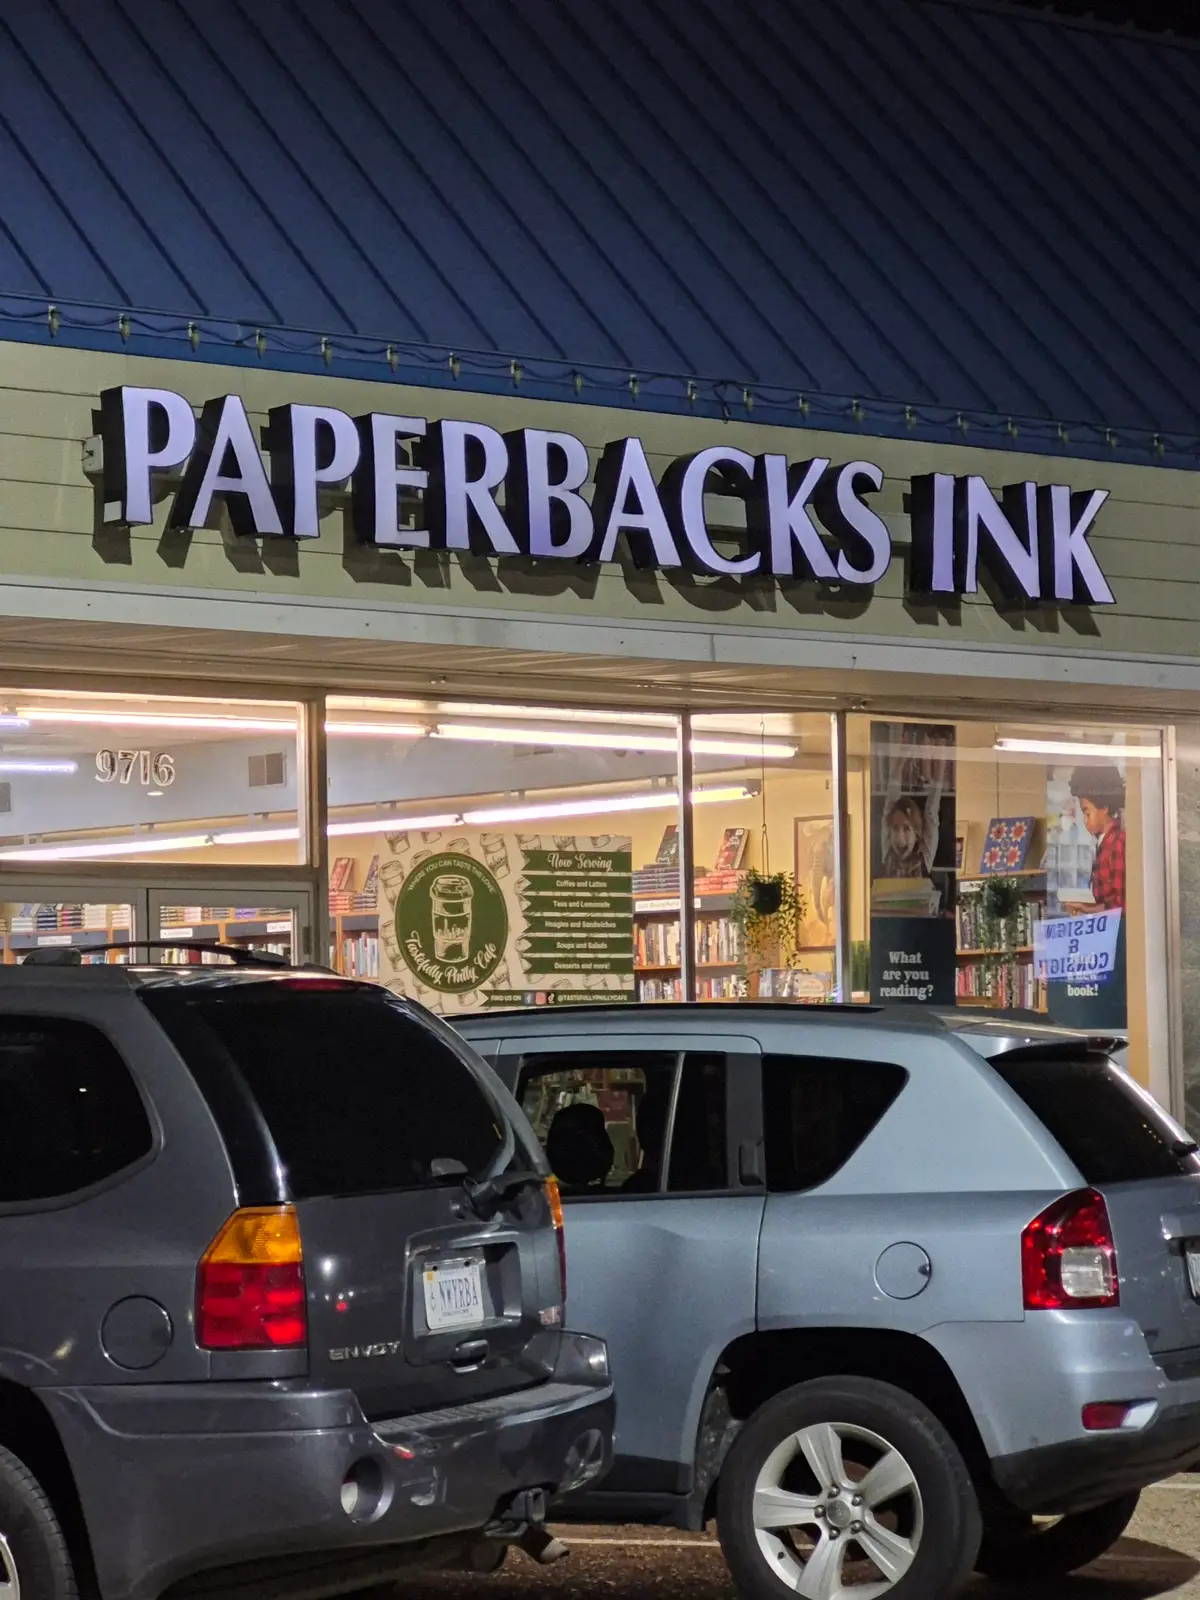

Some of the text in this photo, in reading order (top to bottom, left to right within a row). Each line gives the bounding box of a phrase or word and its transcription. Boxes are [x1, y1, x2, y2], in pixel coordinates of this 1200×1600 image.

[113, 384, 1117, 605] PAPERBACKS INK
[94, 749, 176, 786] 9716
[425, 863, 438, 873] YOU
[438, 860, 452, 868] CAN
[453, 859, 472, 871] TASTE
[547, 852, 613, 873] Now Serving
[555, 880, 608, 888] Coffee and Lattes
[552, 900, 568, 908] Teas
[568, 900, 580, 908] and
[544, 920, 617, 929] Hoagies and Sandwiches
[556, 941, 575, 950] Soups
[587, 942, 608, 950] Salads
[405, 930, 443, 984] Tastefully
[444, 966, 479, 984] Philly
[889, 951, 922, 964] What
[553, 962, 580, 970] Desserts
[580, 962, 592, 970] and
[882, 970, 930, 983] are you
[879, 984, 934, 1001] reading?
[1067, 984, 1099, 997] book!
[328, 1340, 401, 1361] ENVOY
